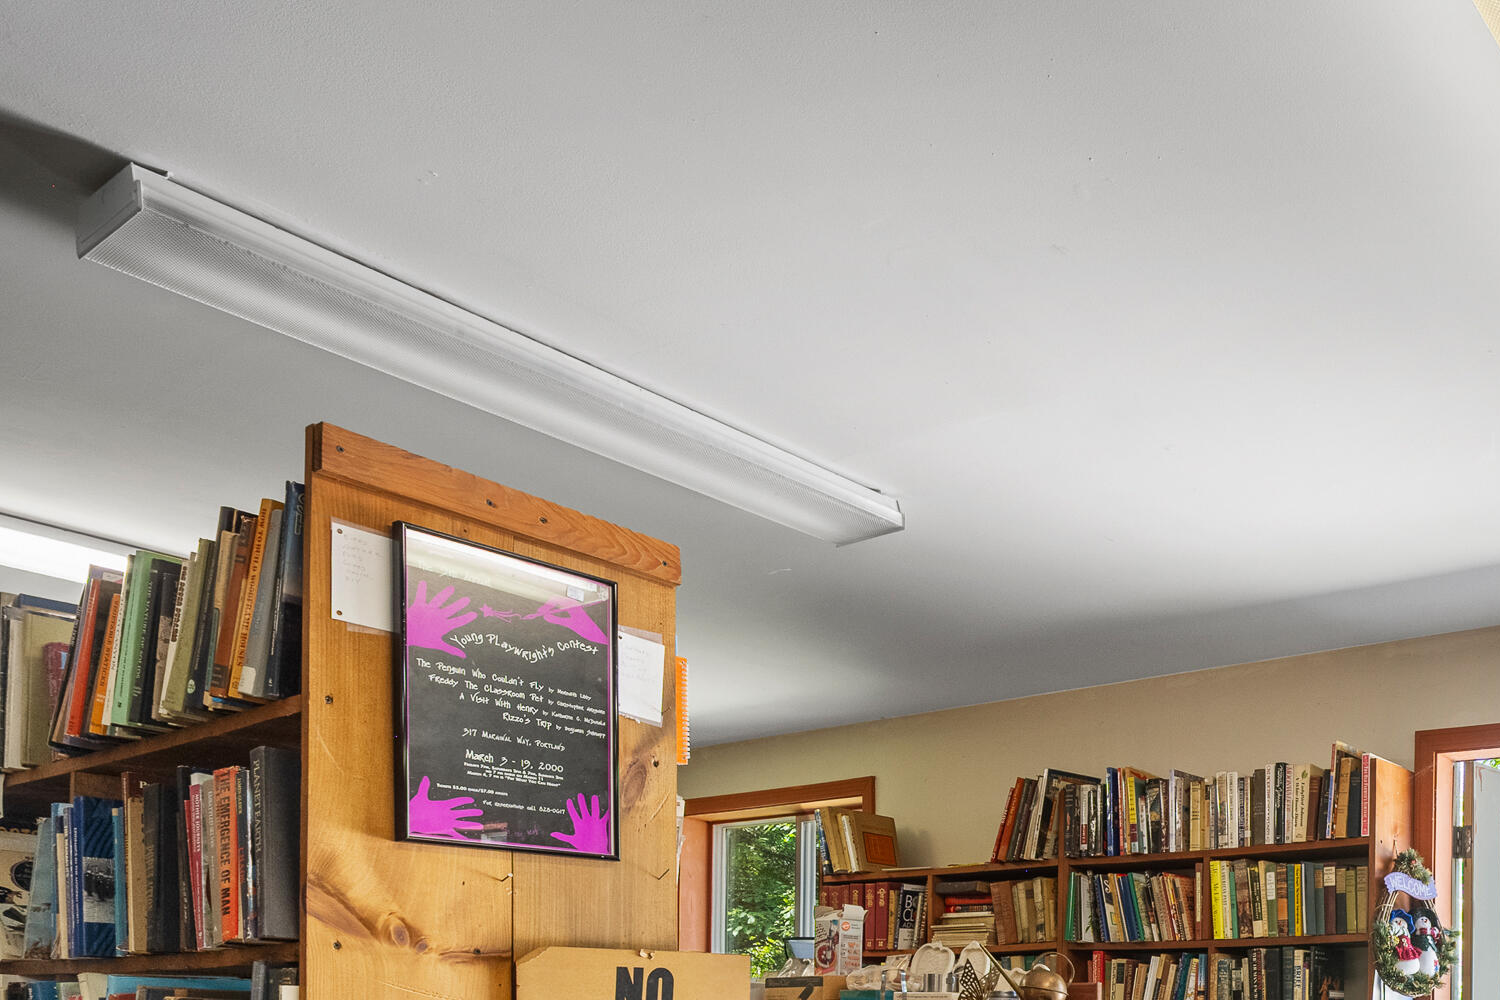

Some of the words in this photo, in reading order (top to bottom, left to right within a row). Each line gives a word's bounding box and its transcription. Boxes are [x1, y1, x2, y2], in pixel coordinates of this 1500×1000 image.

[258, 507, 268, 528] HOW
[256, 529, 265, 542] TO
[450, 633, 483, 648] Young
[557, 641, 598, 654] Contest
[416, 658, 431, 668] The
[436, 662, 466, 675] Penguin
[472, 668, 486, 679] Who
[529, 681, 543, 691] Fly
[465, 680, 478, 691] The
[462, 728, 477, 736] 317
[465, 749, 494, 763] March
[539, 762, 564, 772] 2000
[220, 769, 231, 793] THE
[253, 760, 262, 807] PLANET
[219, 795, 232, 865] EMERGENCE
[254, 810, 262, 852] EARTH
[221, 869, 231, 883] OF
[1389, 875, 1433, 897] WELCOME
[221, 887, 231, 916] MAN
